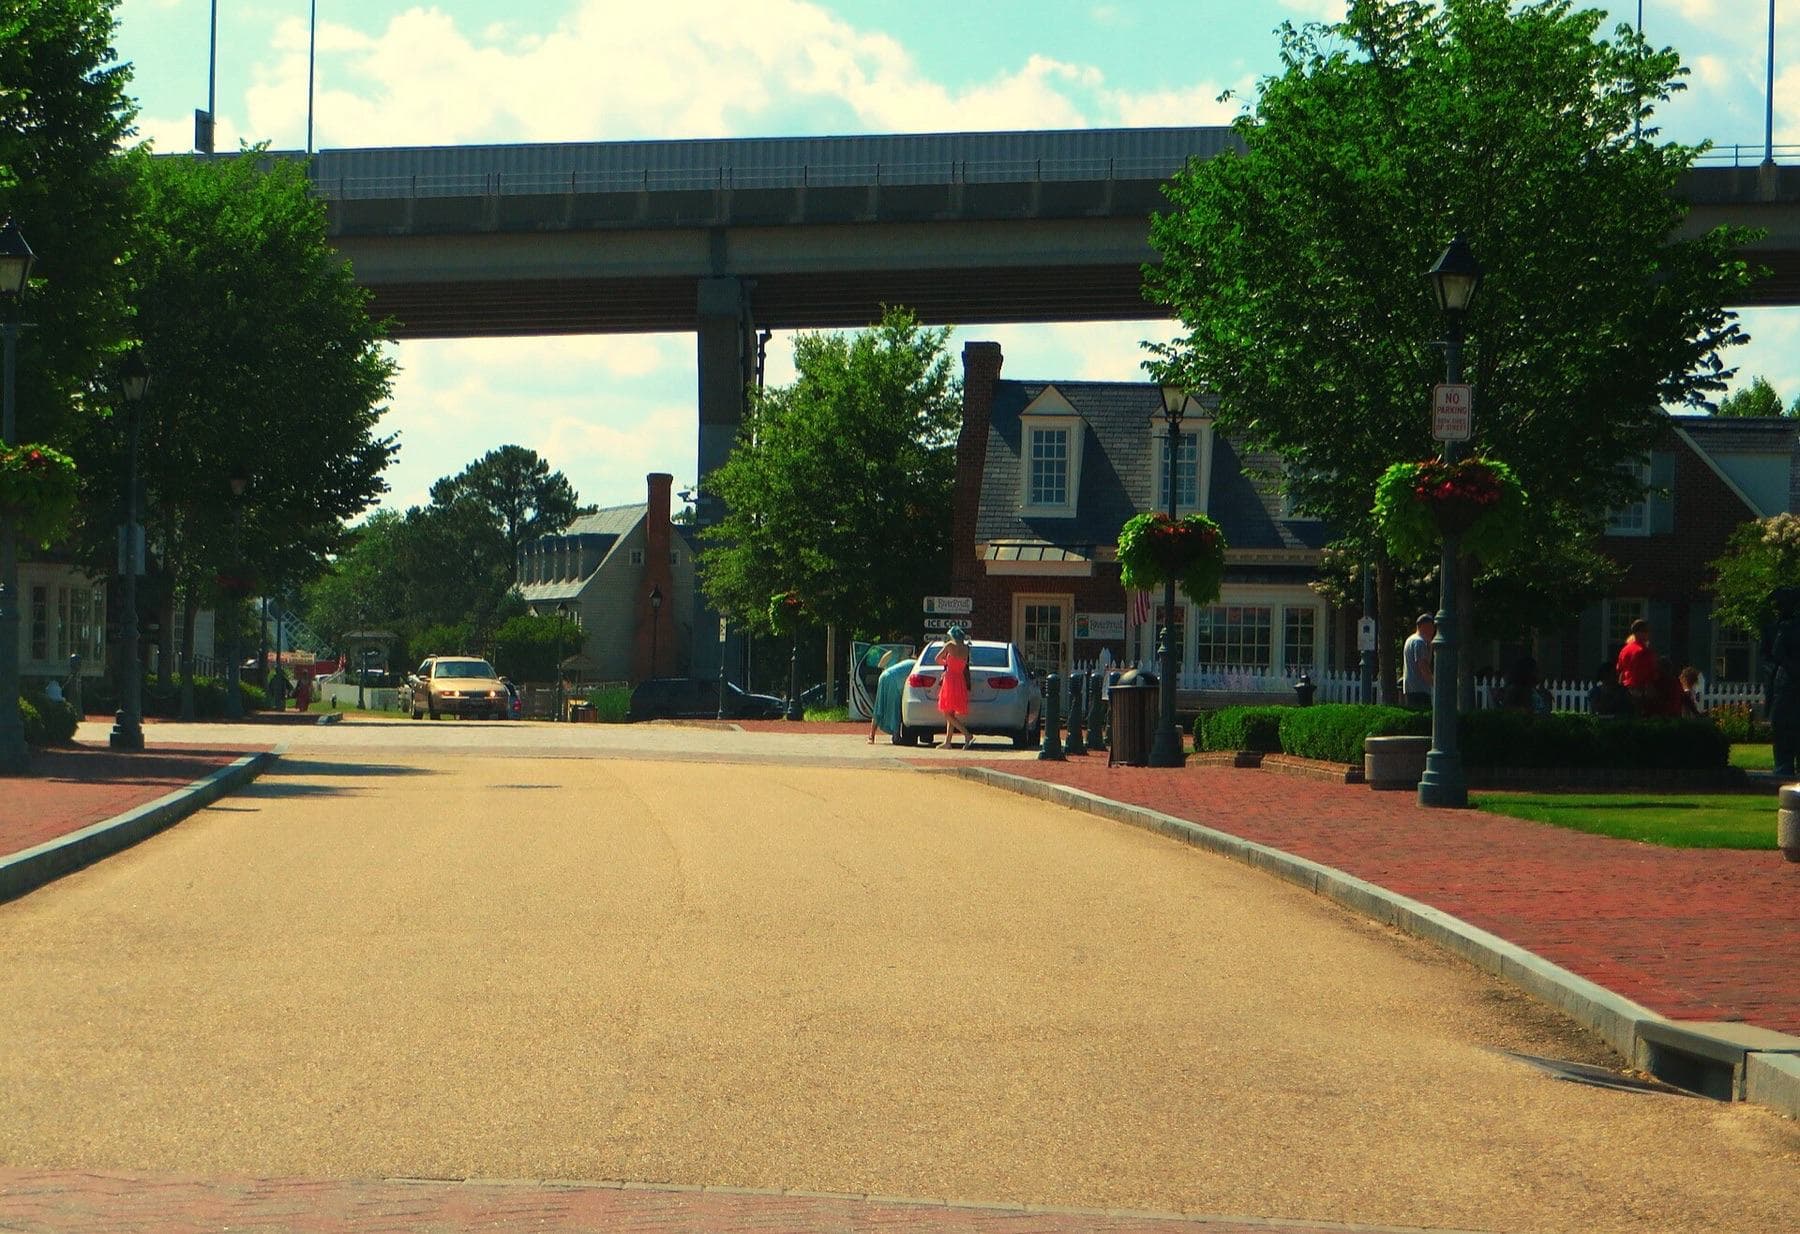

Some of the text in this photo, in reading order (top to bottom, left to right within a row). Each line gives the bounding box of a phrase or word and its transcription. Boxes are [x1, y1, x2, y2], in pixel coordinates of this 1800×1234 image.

[1445, 393, 1460, 404] NO
[1437, 406, 1467, 415] PARKING
[944, 620, 968, 628] COLD
